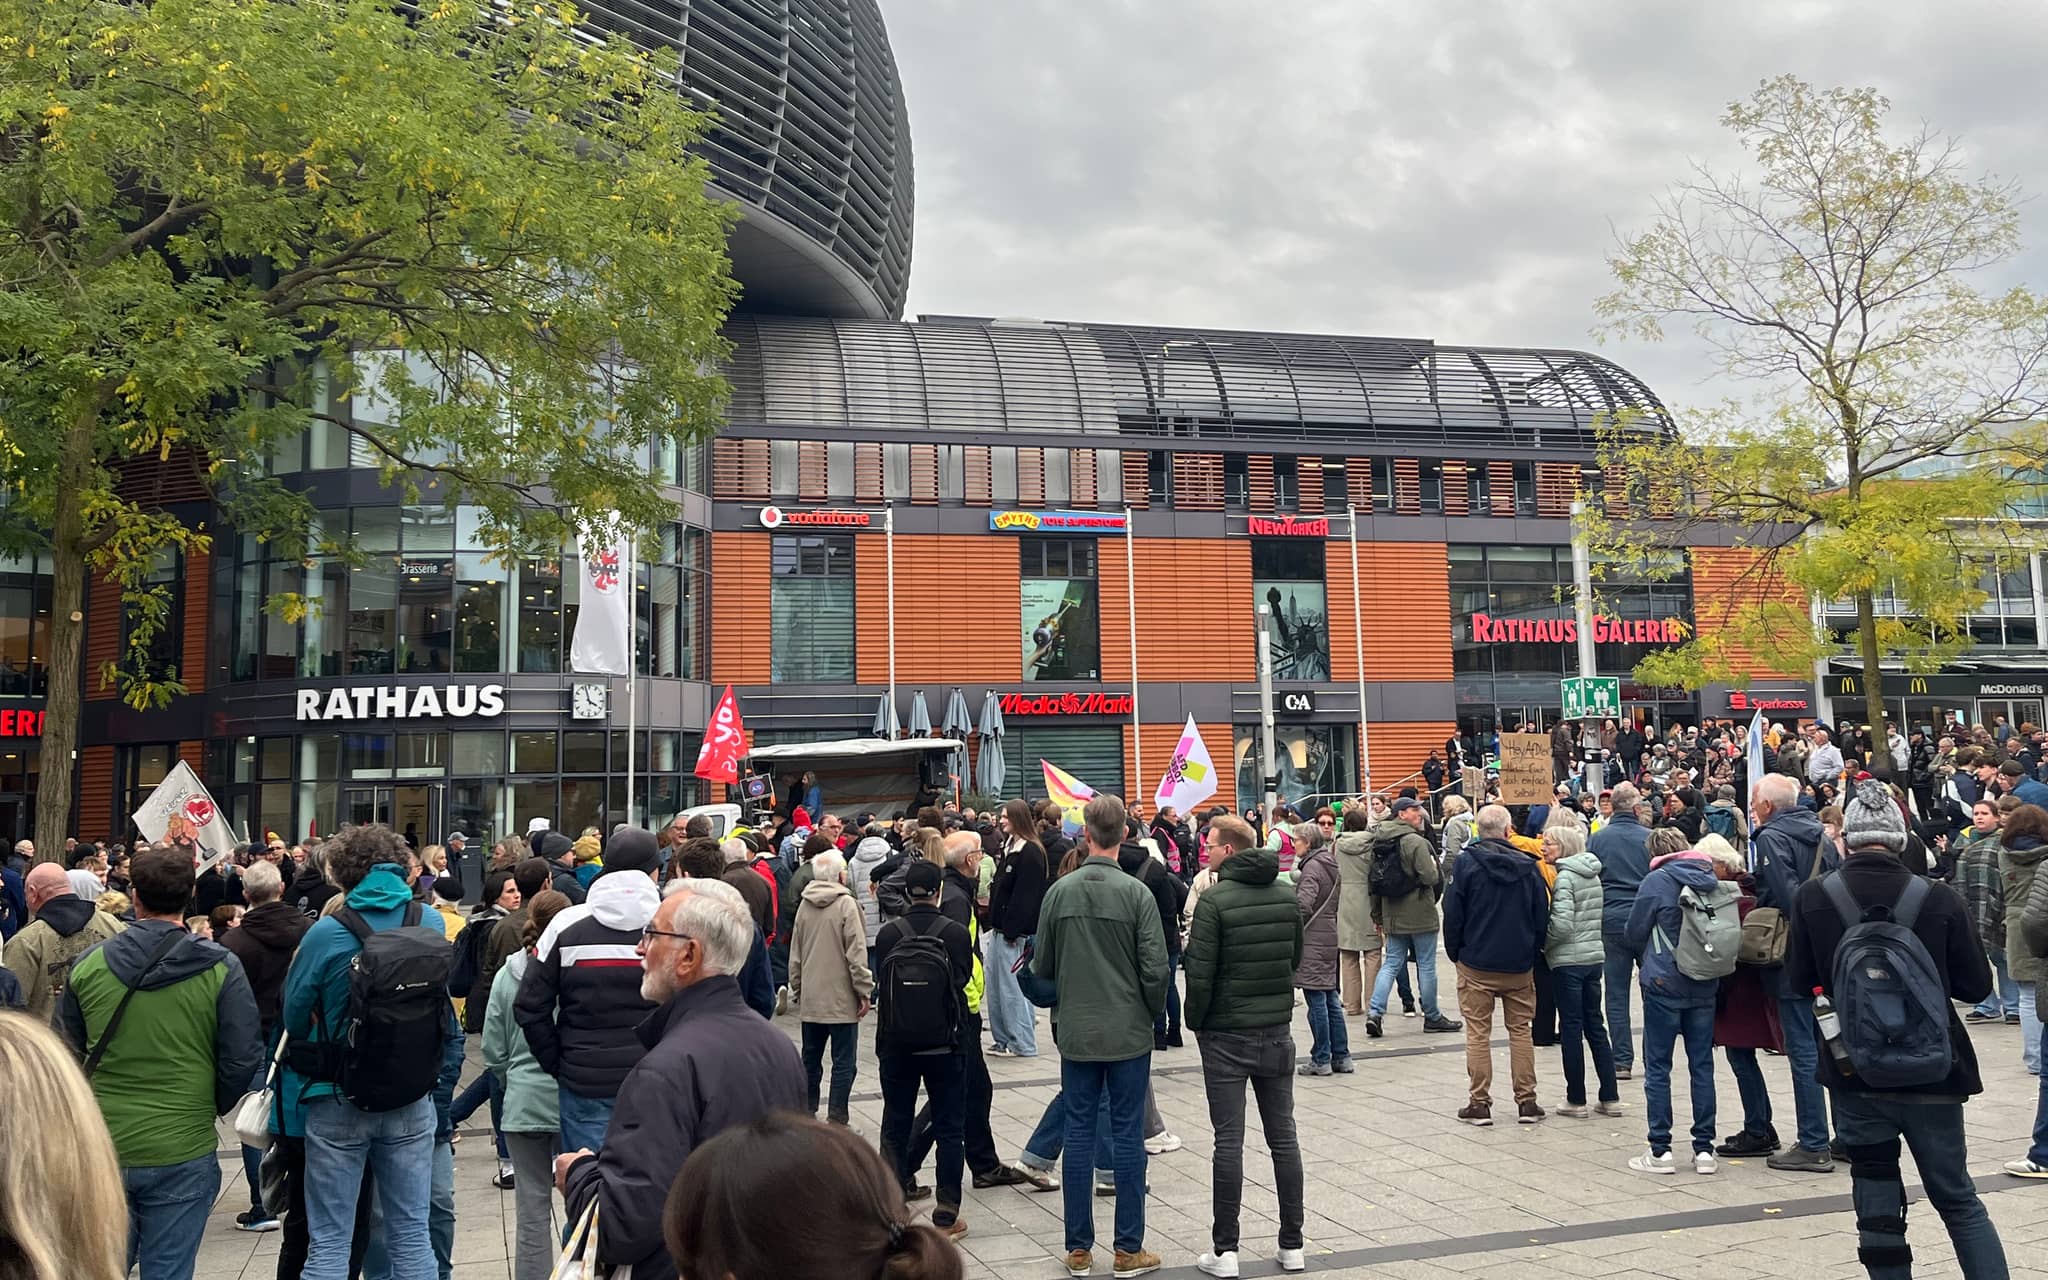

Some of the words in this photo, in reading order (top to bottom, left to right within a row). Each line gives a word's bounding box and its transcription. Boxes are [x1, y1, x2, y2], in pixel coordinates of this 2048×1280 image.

[787, 508, 870, 526] vodafone
[996, 514, 1039, 528] SMYTHS
[401, 563, 438, 574] Brasserie
[1471, 613, 1578, 643] RATHAUS
[1980, 684, 2043, 694] McDonald's
[296, 685, 504, 720] RATHAUS
[999, 692, 1060, 714] Media
[1751, 698, 1808, 709] Sparkasse
